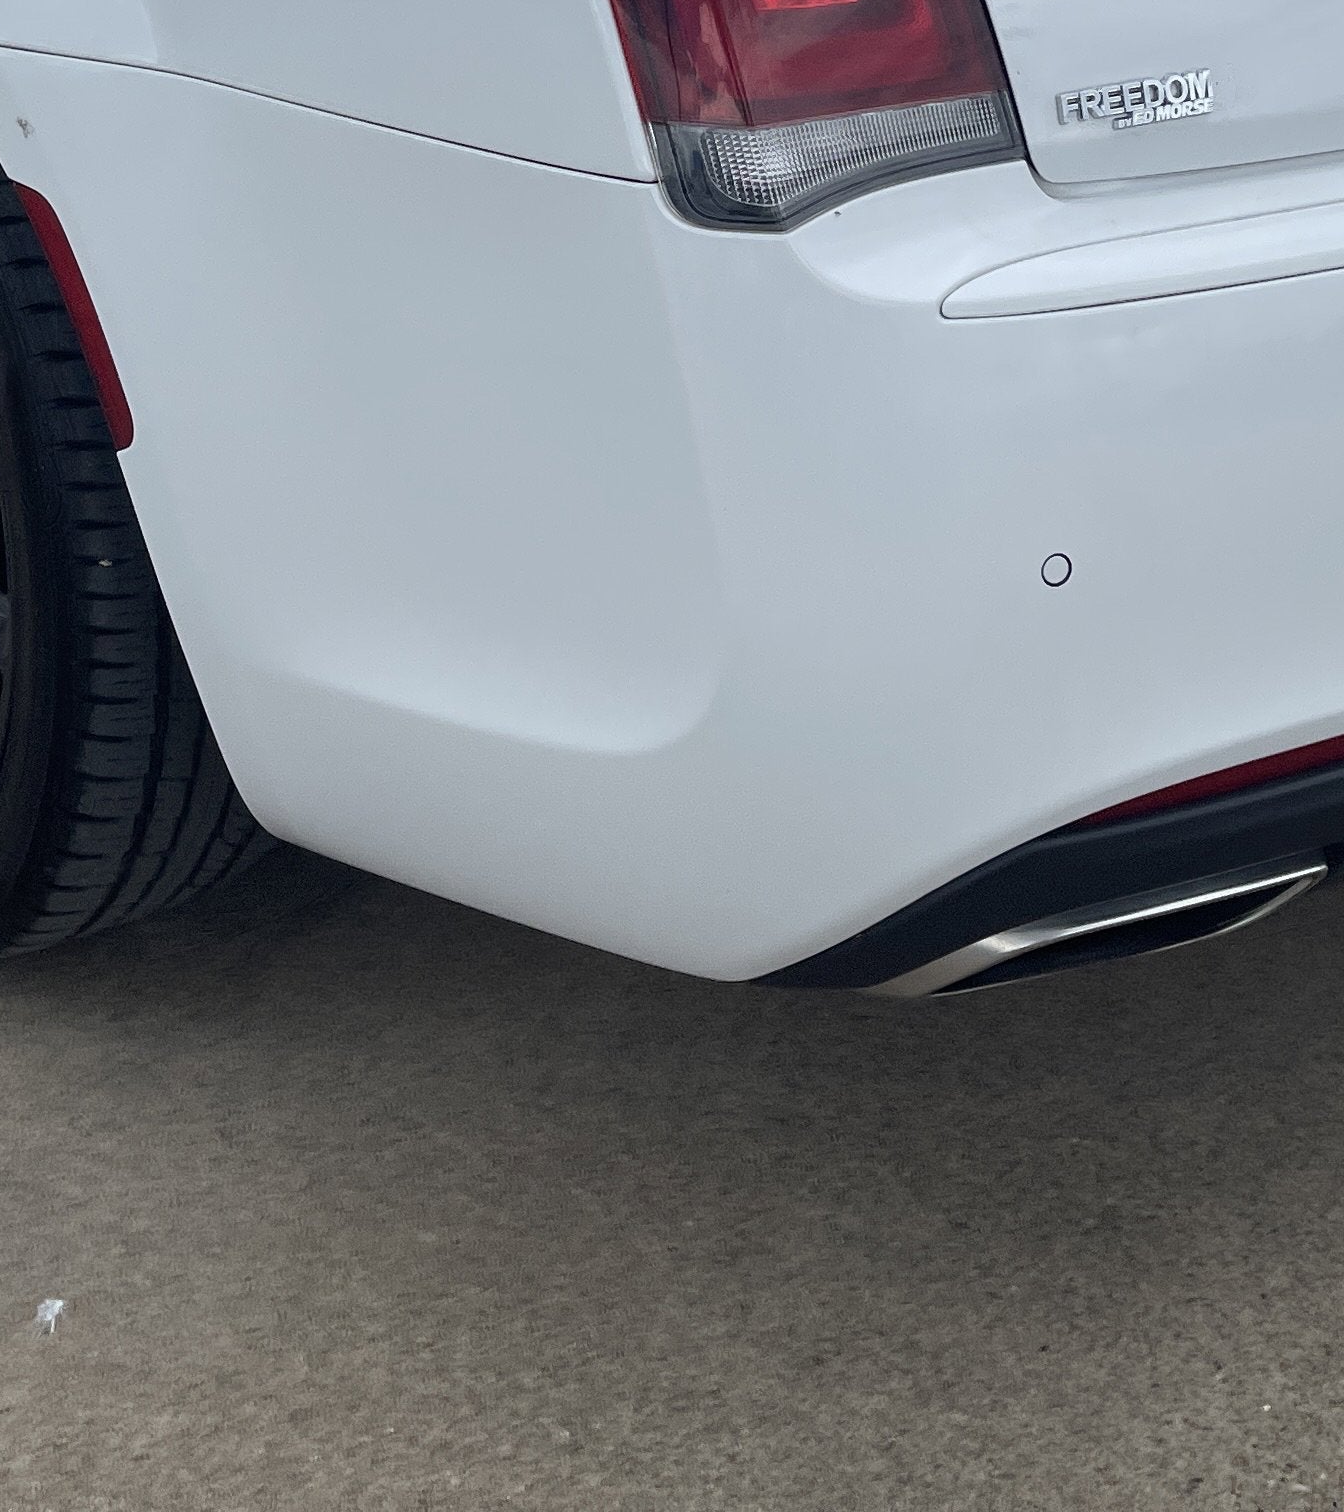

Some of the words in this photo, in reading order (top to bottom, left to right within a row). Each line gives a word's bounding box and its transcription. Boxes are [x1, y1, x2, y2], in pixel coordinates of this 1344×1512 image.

[1058, 69, 1215, 124] FREEDOM
[1132, 109, 1154, 127] ED
[1156, 98, 1214, 122] MORSE
